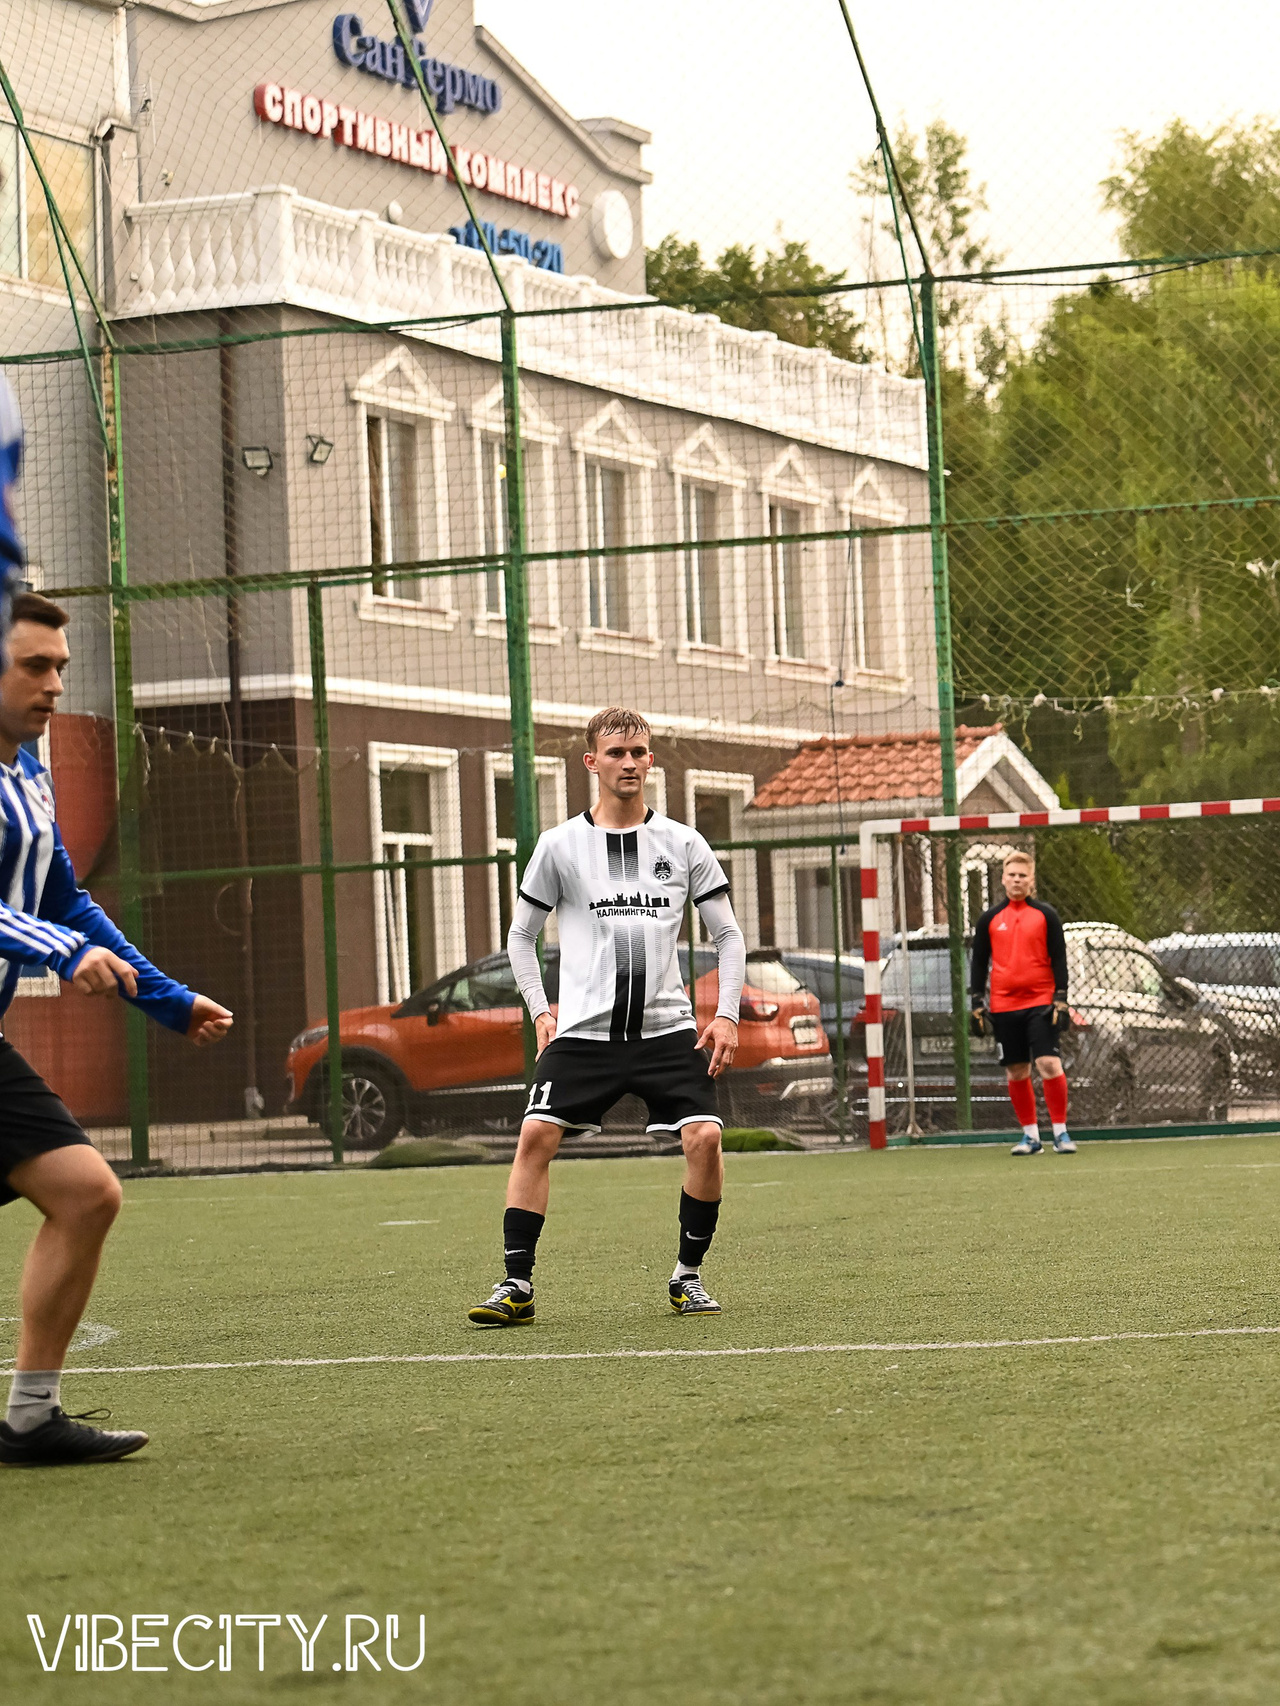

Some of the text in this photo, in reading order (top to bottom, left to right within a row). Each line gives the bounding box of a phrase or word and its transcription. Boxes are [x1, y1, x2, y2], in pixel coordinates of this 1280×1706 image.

[449, 144, 581, 220] КОМПЛЕКС
[596, 907, 658, 919] КАЛИНИНГРАД
[524, 1081, 552, 1115] 11
